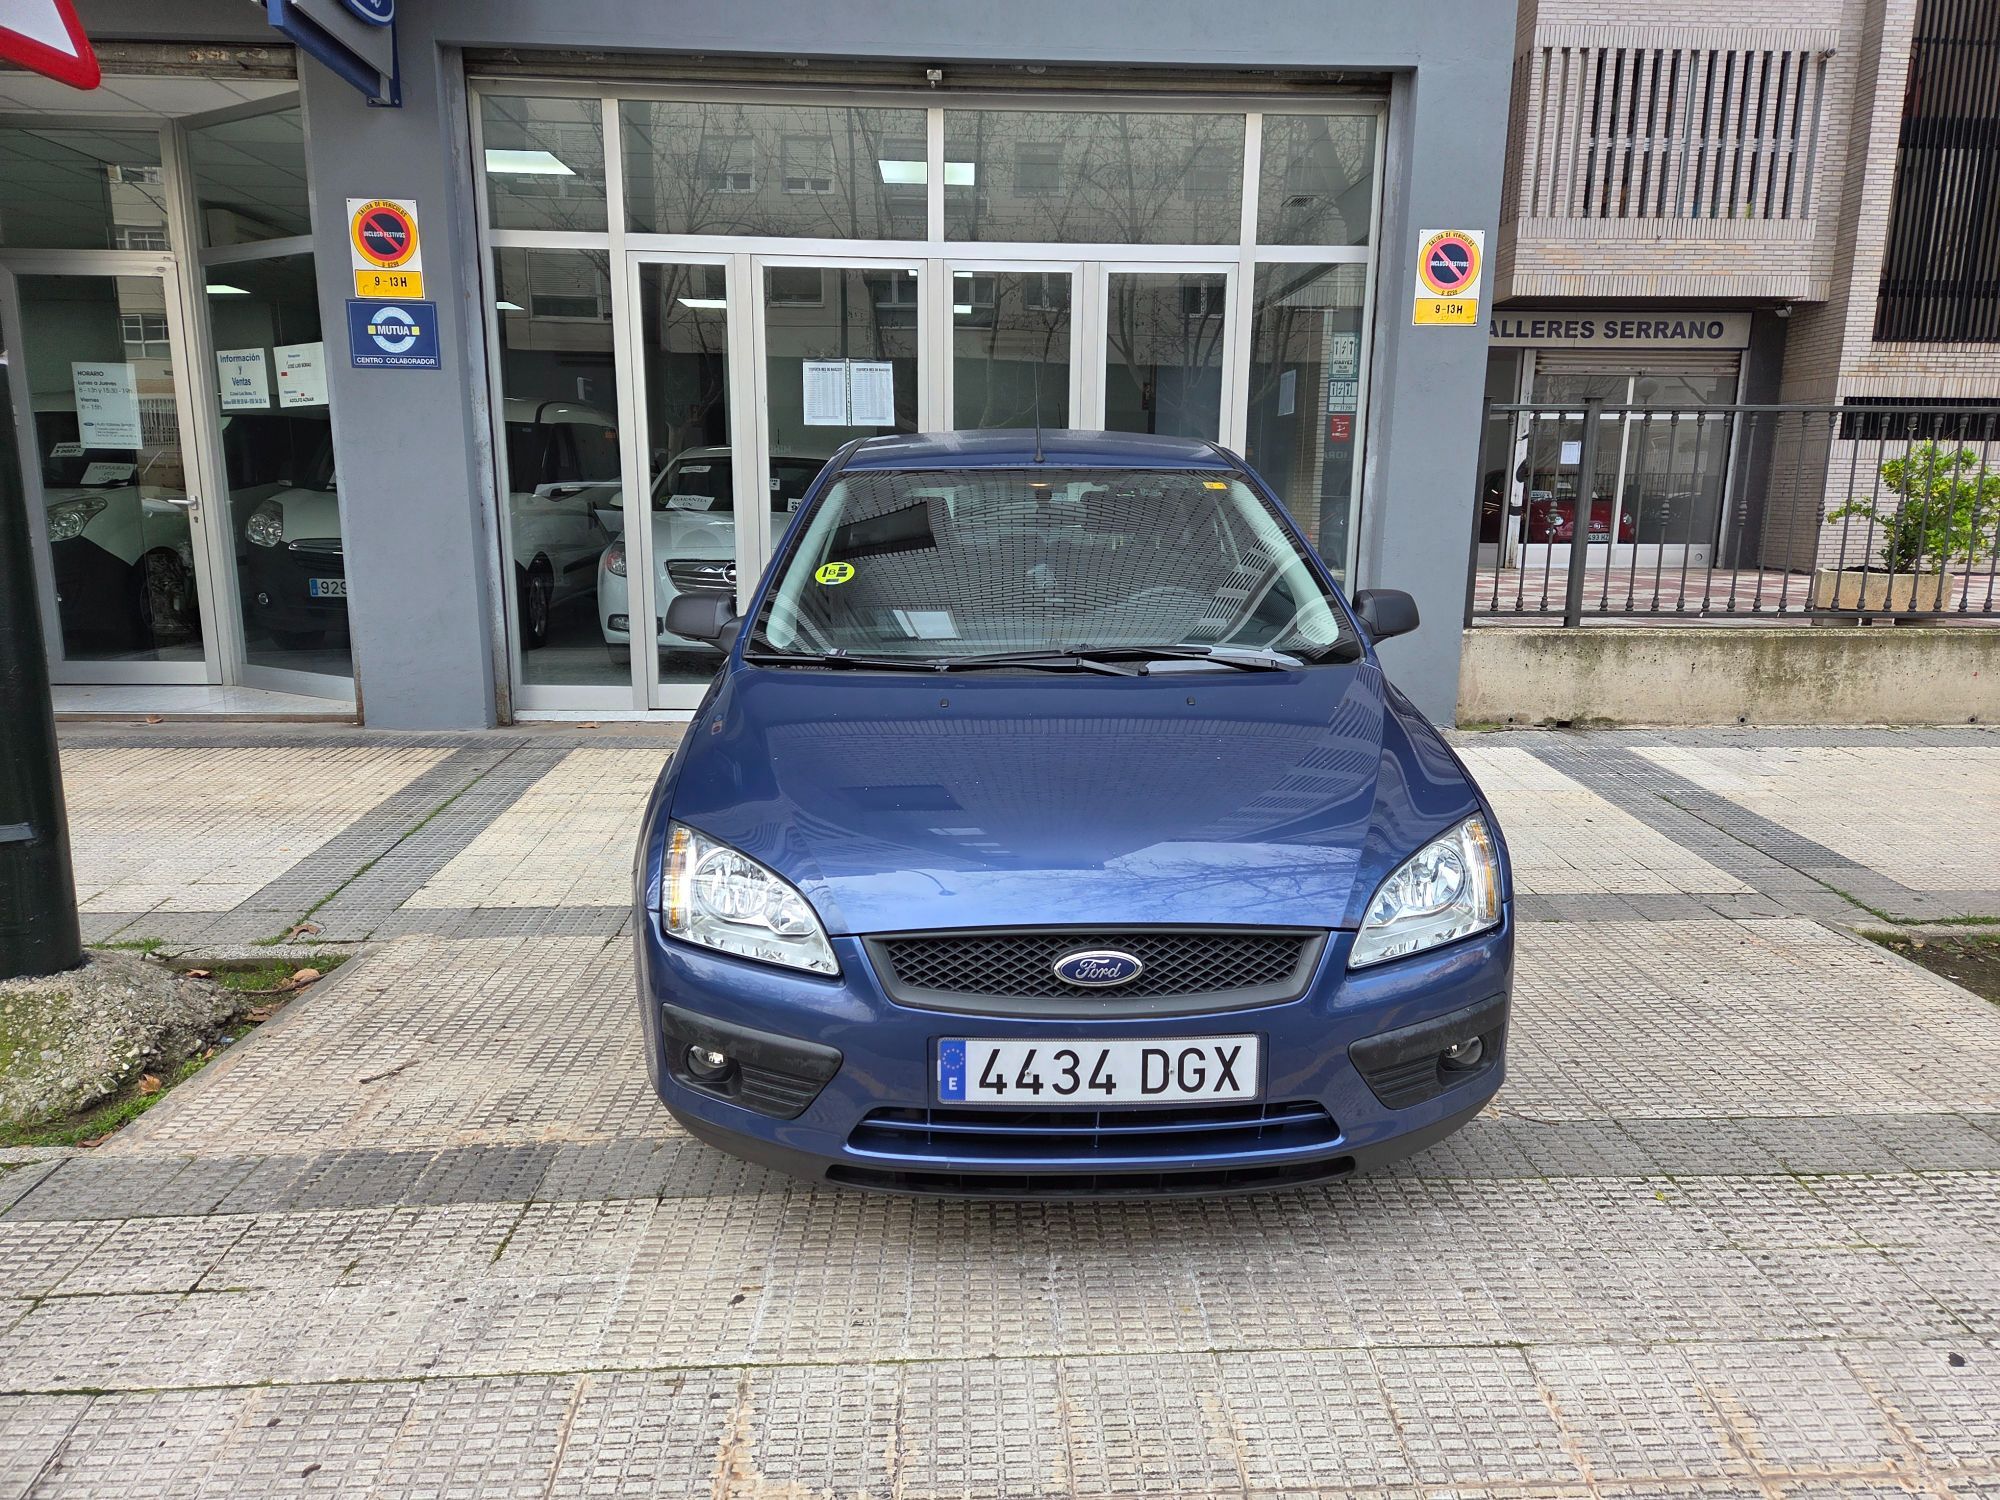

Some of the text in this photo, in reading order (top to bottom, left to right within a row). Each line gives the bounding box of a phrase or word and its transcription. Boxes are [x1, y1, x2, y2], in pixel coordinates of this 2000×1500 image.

[363, 230, 406, 239] INCLUSO FESTIVOS
[1448, 260, 1469, 268] FESTIVOS
[377, 325, 410, 336] MUTUA
[1603, 320, 1724, 339] SERRANO
[220, 353, 261, 364] Información
[386, 358, 435, 366] COLABORADOR
[231, 377, 252, 387] Ventas
[1074, 957, 1122, 980] Ford
[948, 1045, 1242, 1096] E 4434 DGX
